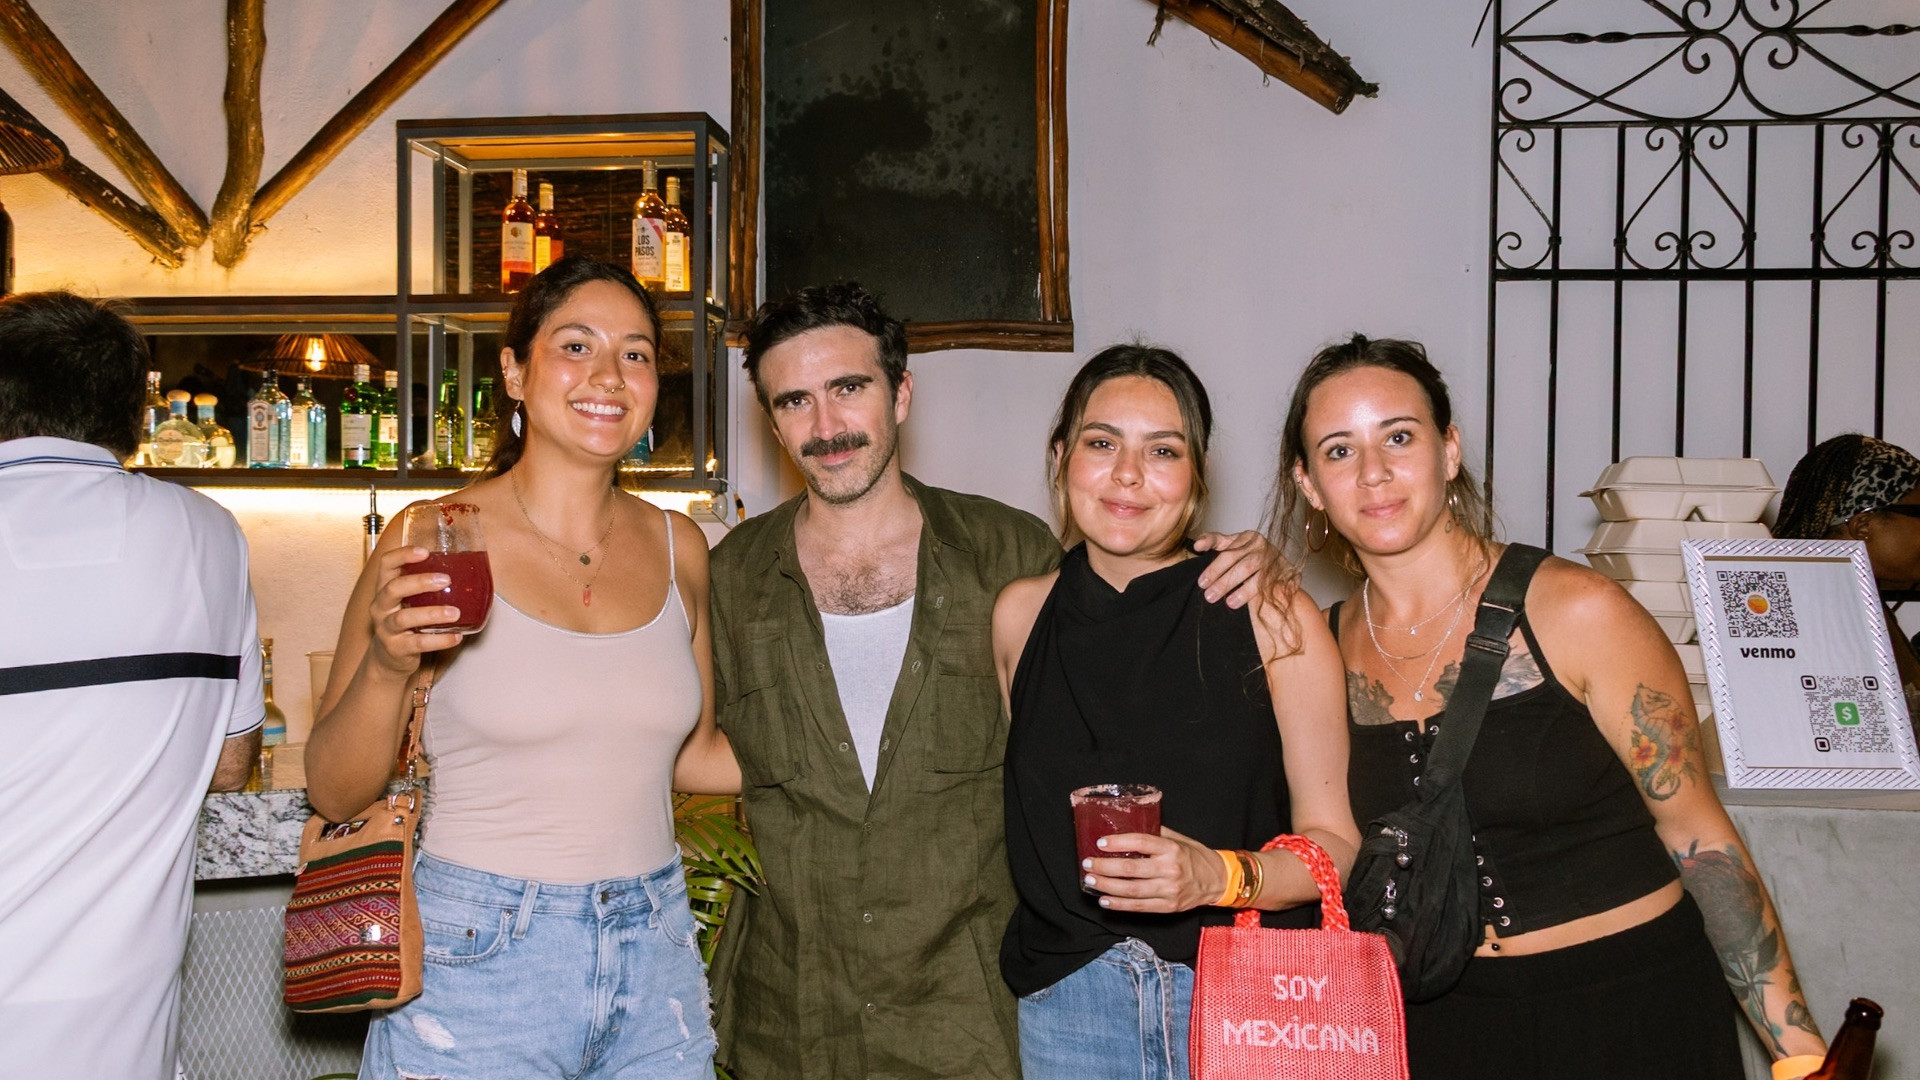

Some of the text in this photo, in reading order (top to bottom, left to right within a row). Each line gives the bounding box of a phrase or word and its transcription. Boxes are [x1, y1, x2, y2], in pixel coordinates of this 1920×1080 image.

[637, 235, 650, 245] LOS
[1740, 647, 1796, 659] venmo
[1273, 974, 1327, 1002] SOY
